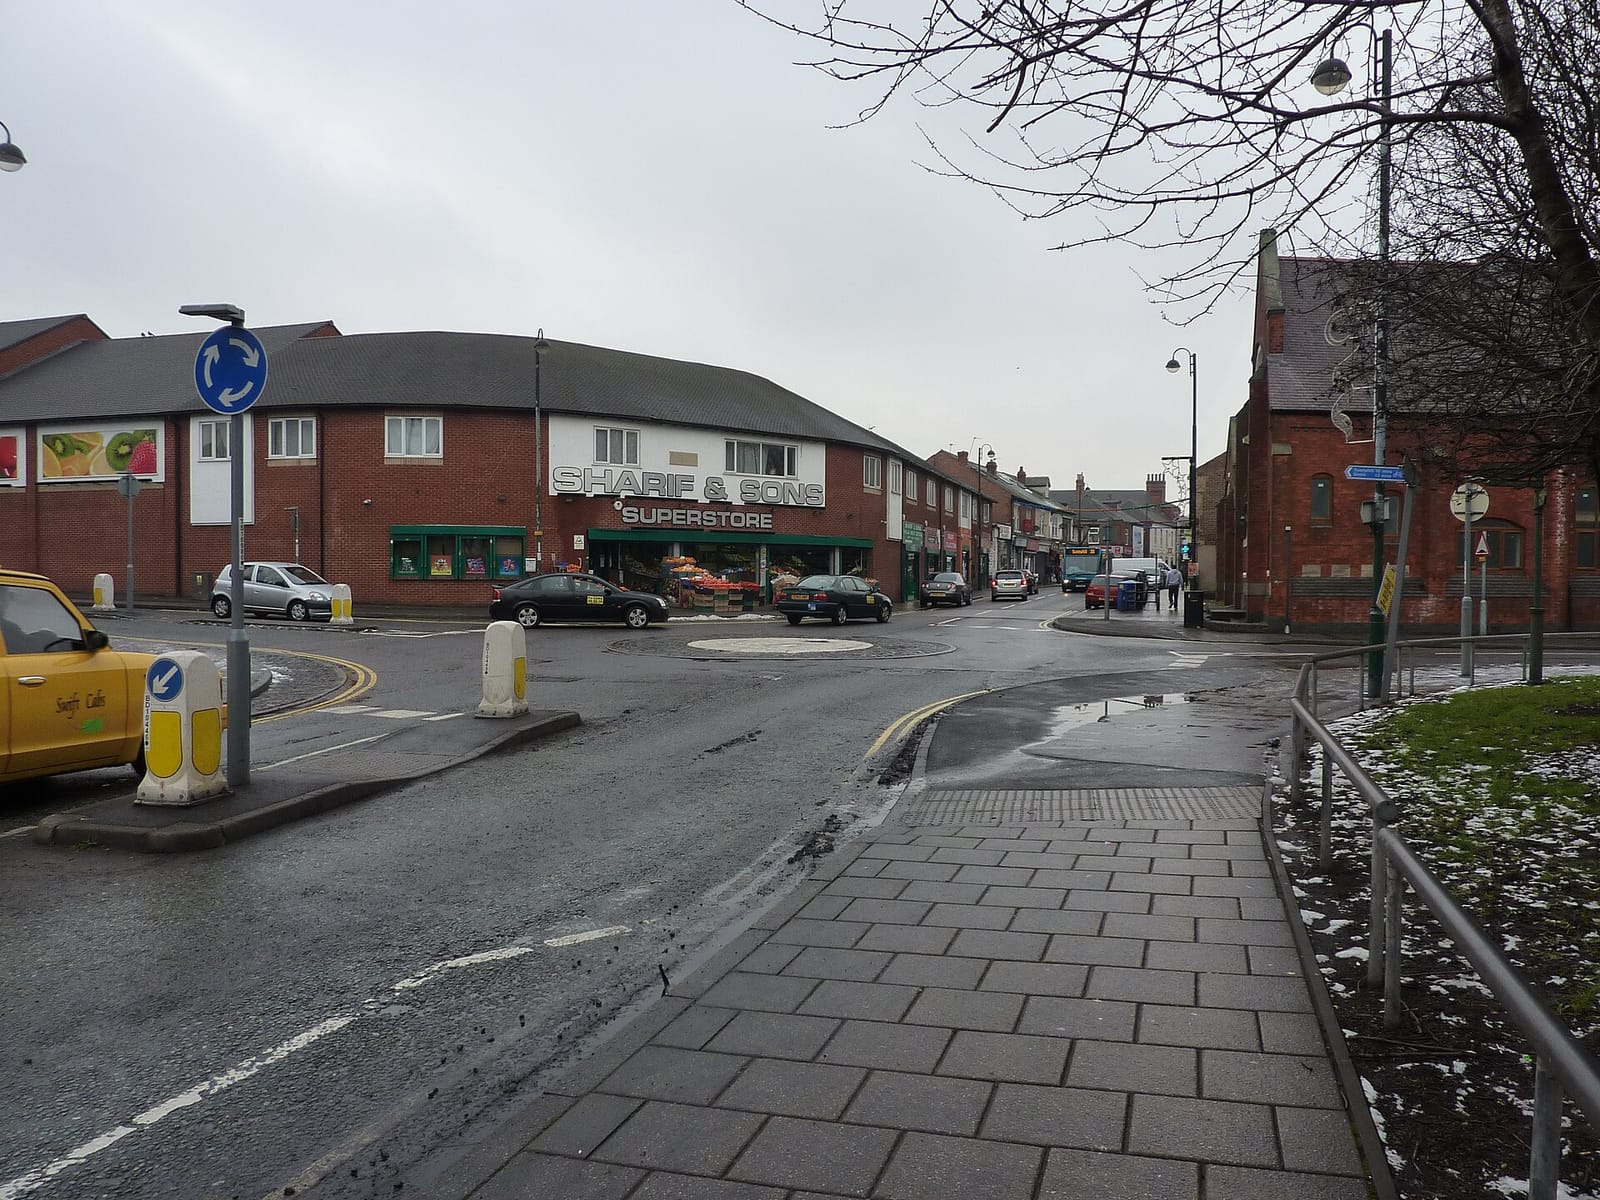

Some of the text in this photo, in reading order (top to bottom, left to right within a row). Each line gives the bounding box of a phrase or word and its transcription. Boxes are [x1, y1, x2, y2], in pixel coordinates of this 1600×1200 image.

[553, 466, 824, 505] SHARIF & SONS
[622, 506, 773, 529] SUPERSTORE
